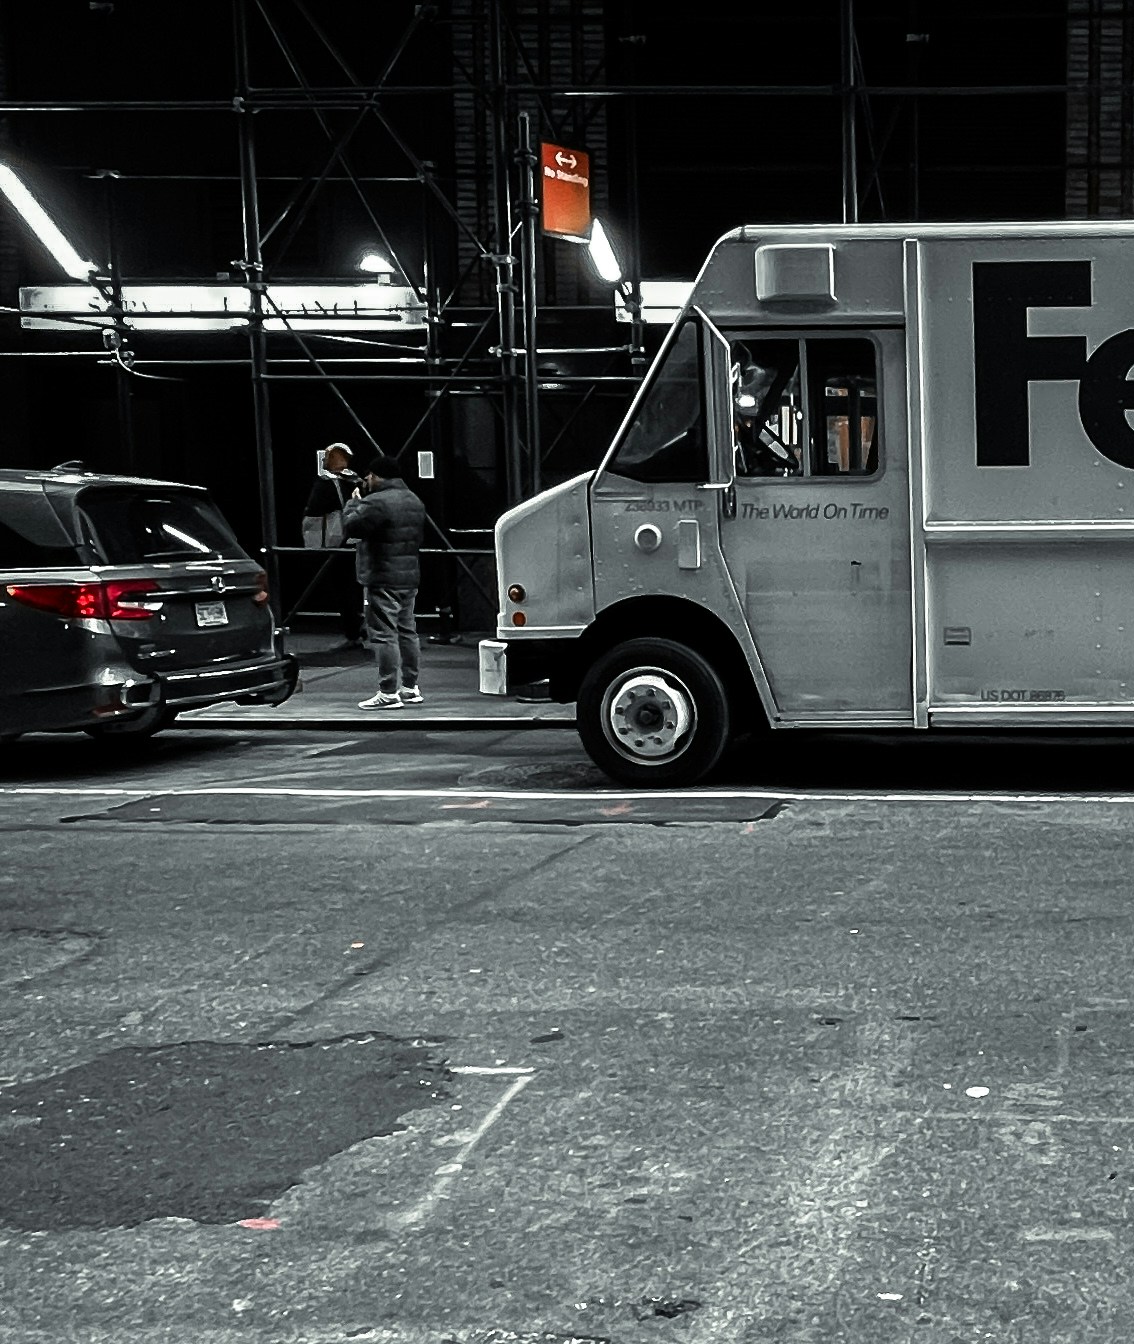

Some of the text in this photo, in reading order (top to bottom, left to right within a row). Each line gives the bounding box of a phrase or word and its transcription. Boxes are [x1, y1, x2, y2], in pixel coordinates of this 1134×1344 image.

[741, 503, 889, 519] The World On Time
[980, 689, 999, 702] US
[1001, 689, 1028, 702] DOT
